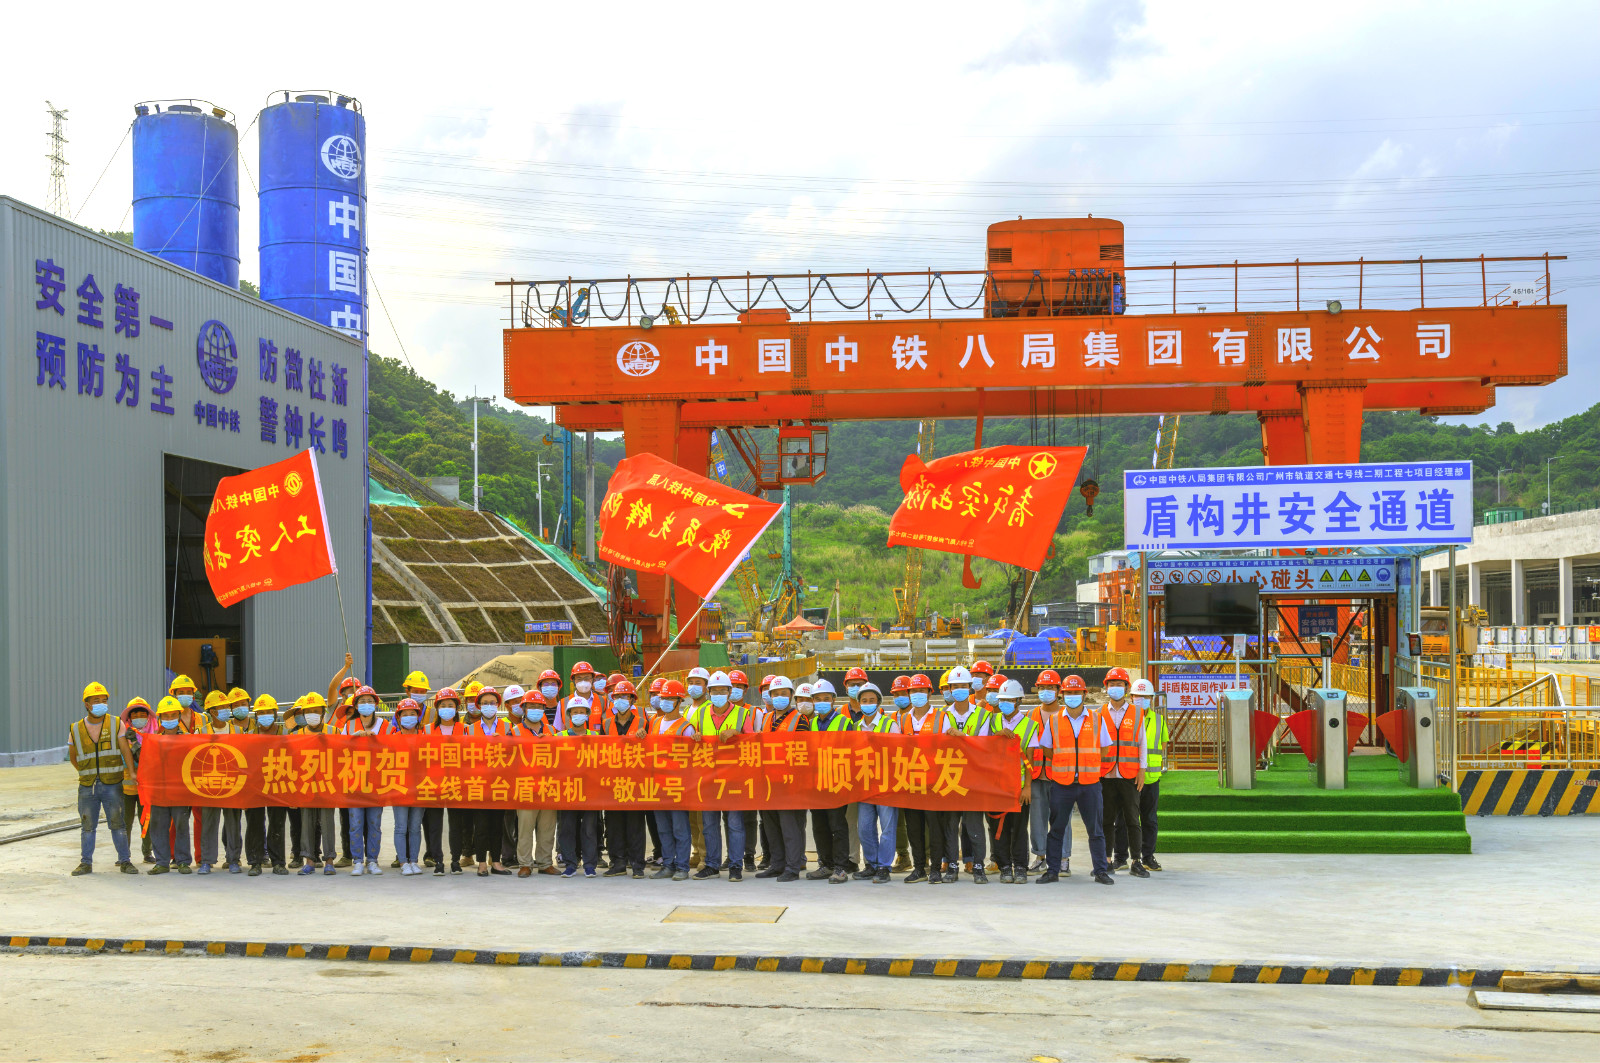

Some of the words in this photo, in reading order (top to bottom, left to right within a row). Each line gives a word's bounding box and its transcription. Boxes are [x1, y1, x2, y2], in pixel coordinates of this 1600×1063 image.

[35, 258, 174, 338] 安全第一
[35, 331, 175, 415] 预防为主
[258, 337, 348, 406] 防微杜渐
[695, 323, 1451, 375] 中国中铁八局集团有限公司
[195, 400, 241, 433] 中国中铁
[259, 396, 348, 458] 警钟长鸣
[1149, 467, 1464, 484] 中国中铁八局集团有限公司广州市轨道交通七号线二期工程七项目经理部
[1142, 488, 1456, 539] 盾构井安全通道
[1180, 695, 1224, 706] 禁止入
[262, 748, 409, 796] 热烈祝贺
[418, 740, 809, 769] 中国中铁八局广州地铁七号线二期工程
[817, 746, 969, 797] 顺利始发
